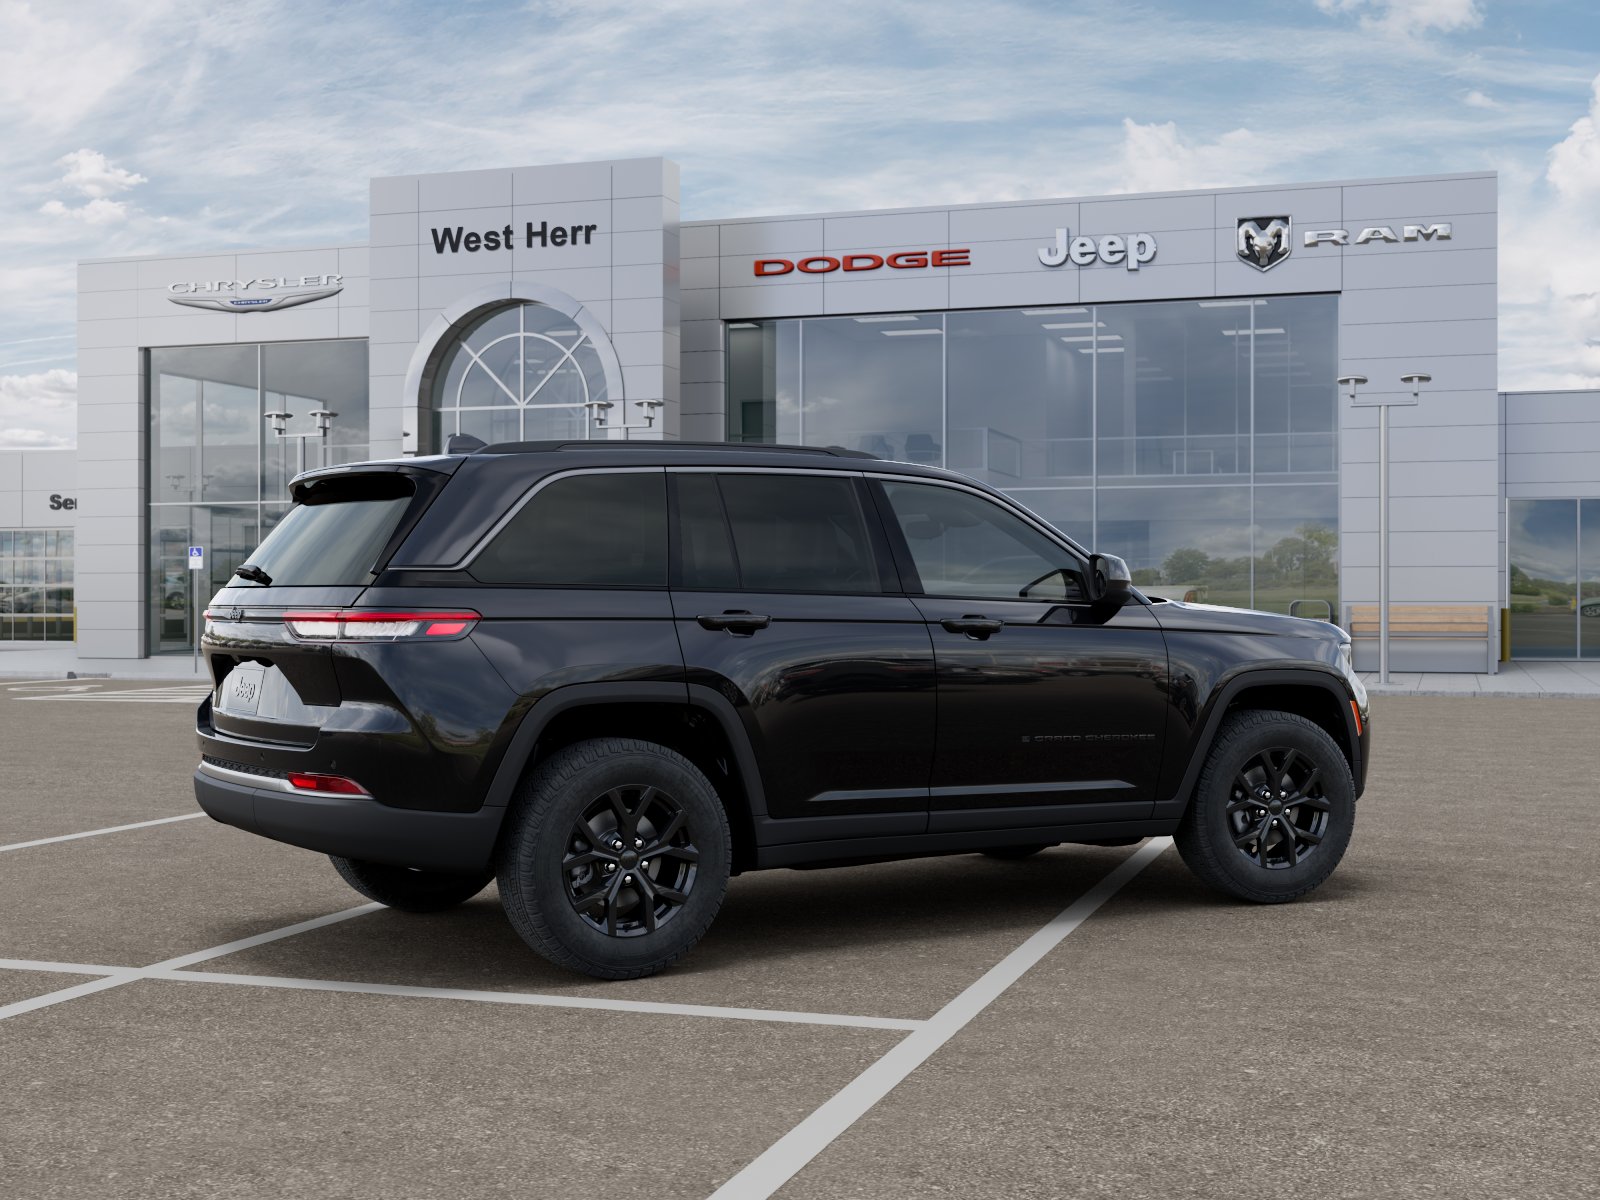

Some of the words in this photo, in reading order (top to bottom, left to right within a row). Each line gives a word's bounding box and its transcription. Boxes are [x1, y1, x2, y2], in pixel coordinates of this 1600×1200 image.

[431, 224, 514, 254] West
[526, 221, 597, 247] Herr
[1037, 227, 1157, 271] Jeep
[1304, 223, 1452, 248] RAM
[754, 249, 971, 277] DODGE
[167, 273, 344, 294] CHRYSLER
[234, 676, 256, 703] Jeep
